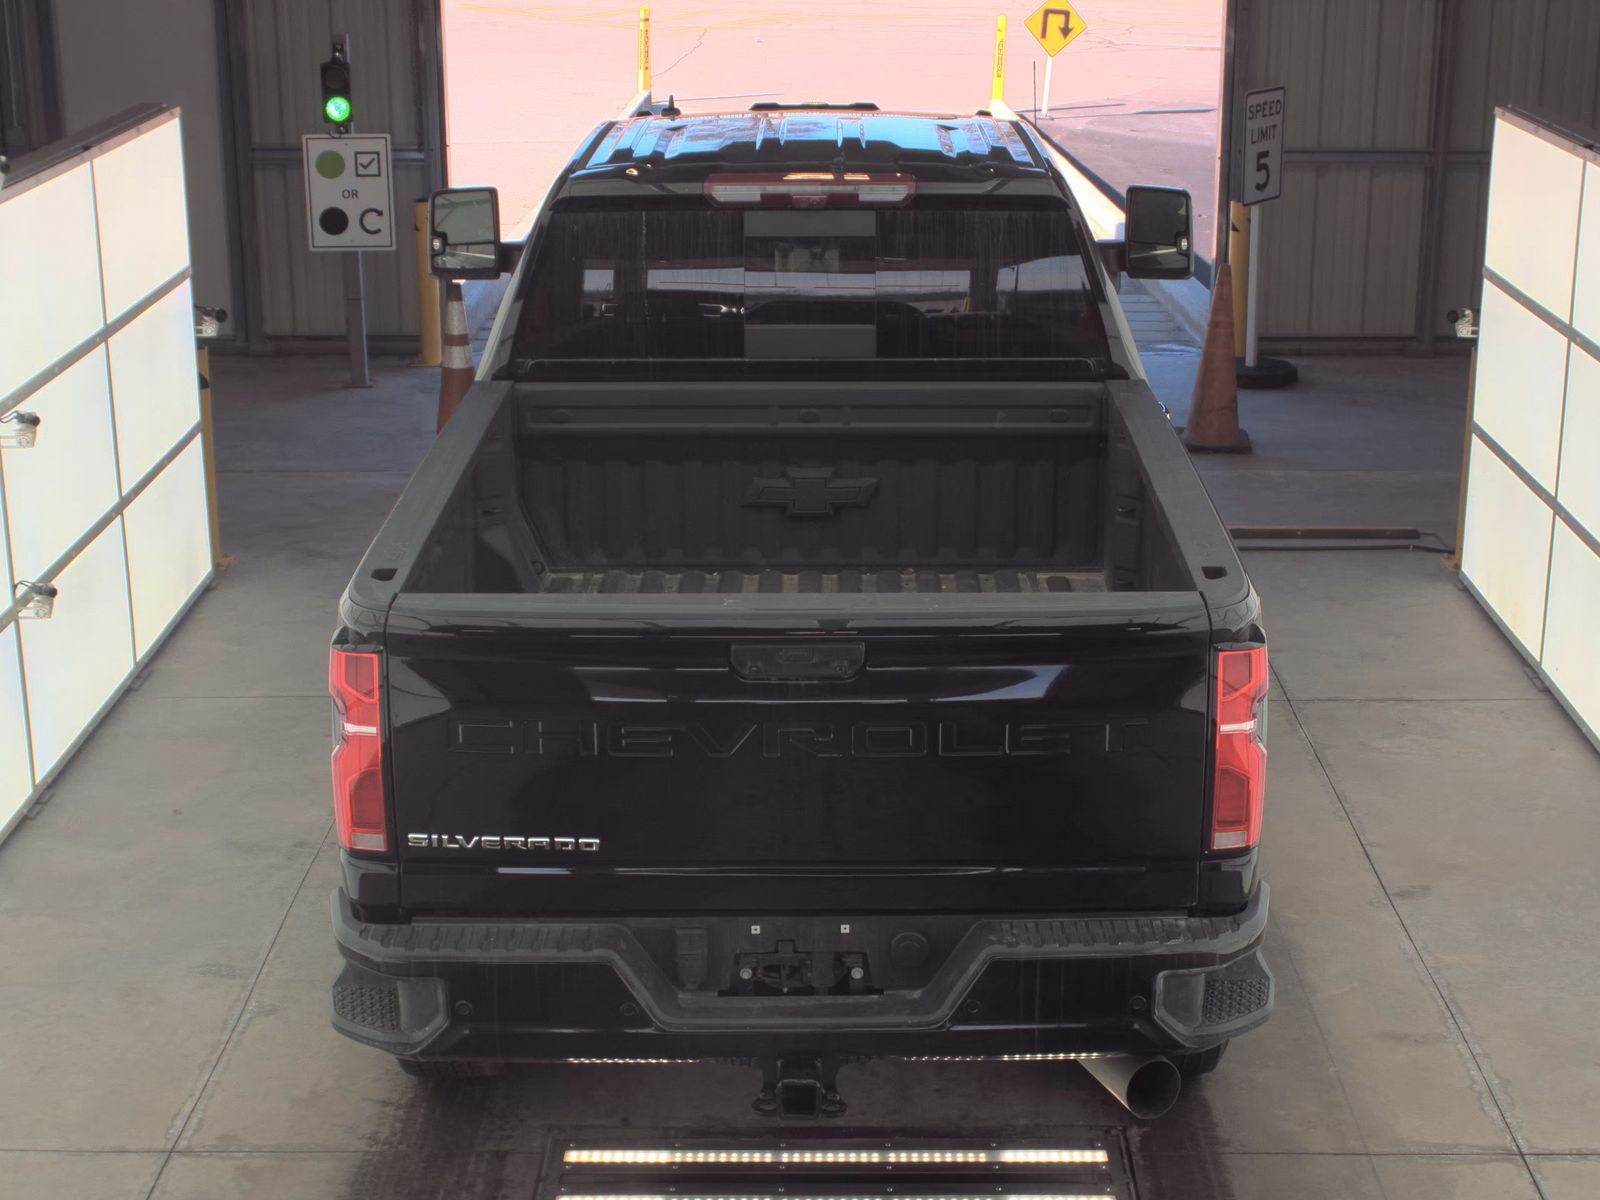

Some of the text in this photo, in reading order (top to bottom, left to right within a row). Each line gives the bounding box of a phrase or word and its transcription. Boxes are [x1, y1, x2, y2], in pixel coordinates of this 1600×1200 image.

[1248, 99, 1282, 120] SPEED
[1251, 124, 1277, 144] LIMIT
[1255, 150, 1270, 191] 5
[341, 188, 359, 200] OR
[447, 718, 1152, 758] CHEVROLET
[407, 832, 600, 851] SILVERADO
